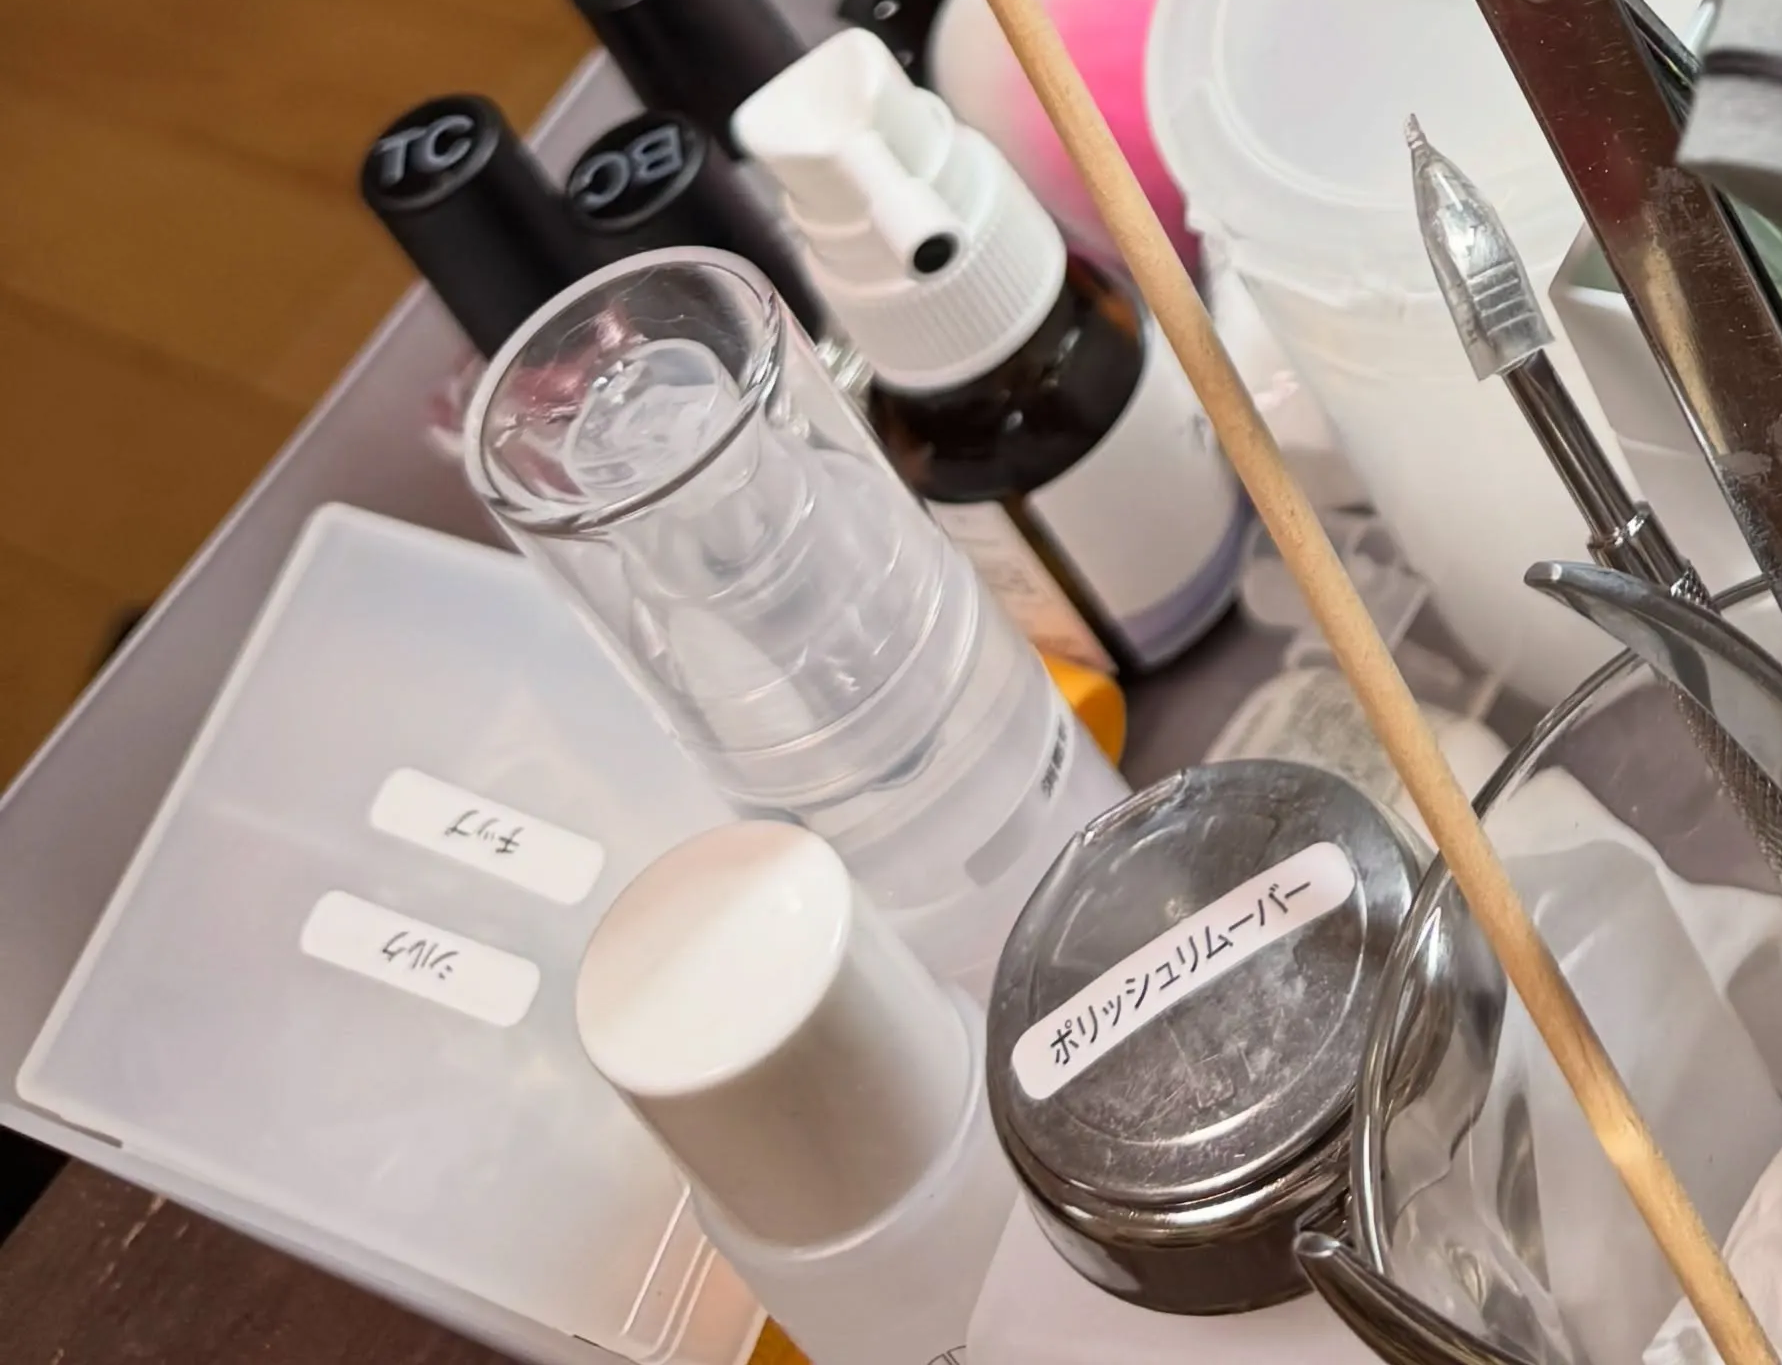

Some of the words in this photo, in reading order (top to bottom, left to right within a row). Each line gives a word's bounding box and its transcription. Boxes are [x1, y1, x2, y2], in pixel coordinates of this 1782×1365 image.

[376, 114, 476, 186] TC
[583, 122, 684, 211] BC
[1049, 881, 1312, 1066] ポリッシュリムーバー
